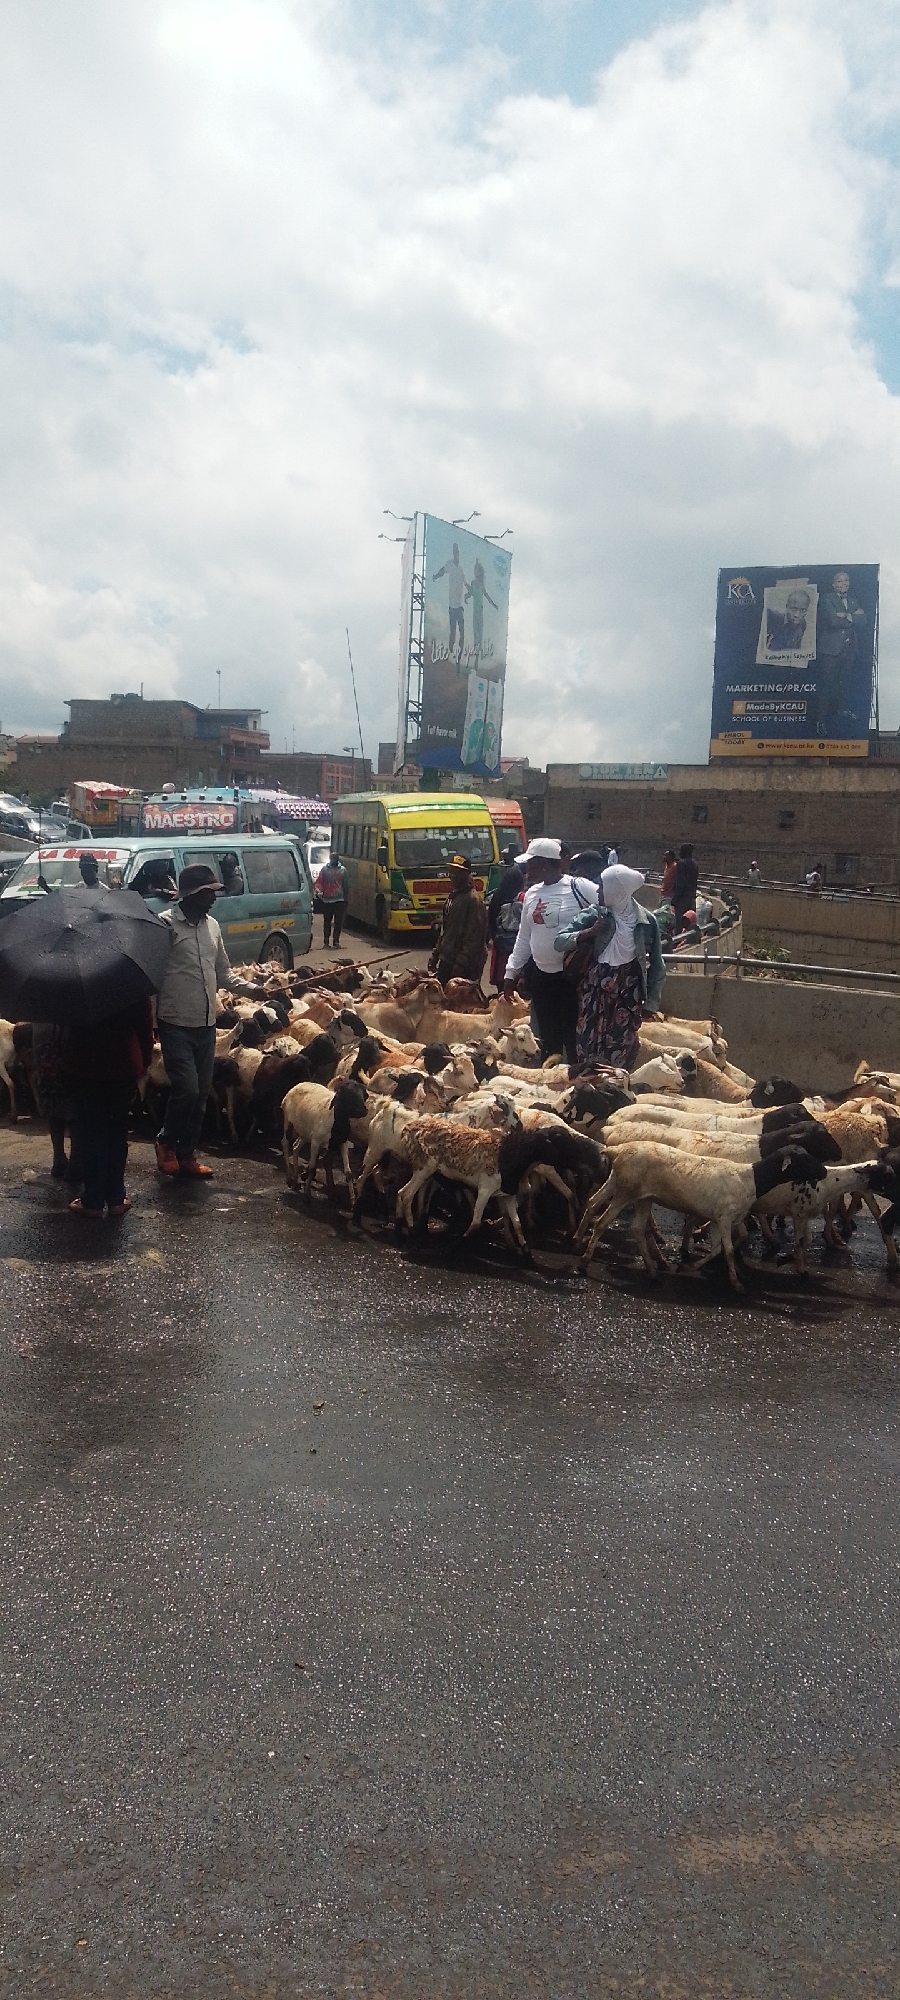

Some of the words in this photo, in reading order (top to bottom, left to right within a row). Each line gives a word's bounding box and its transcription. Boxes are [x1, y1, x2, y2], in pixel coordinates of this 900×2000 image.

[727, 584, 756, 599] KCA
[725, 683, 817, 693] MARKETING/PR/CX
[145, 813, 234, 829] MAESTRO
